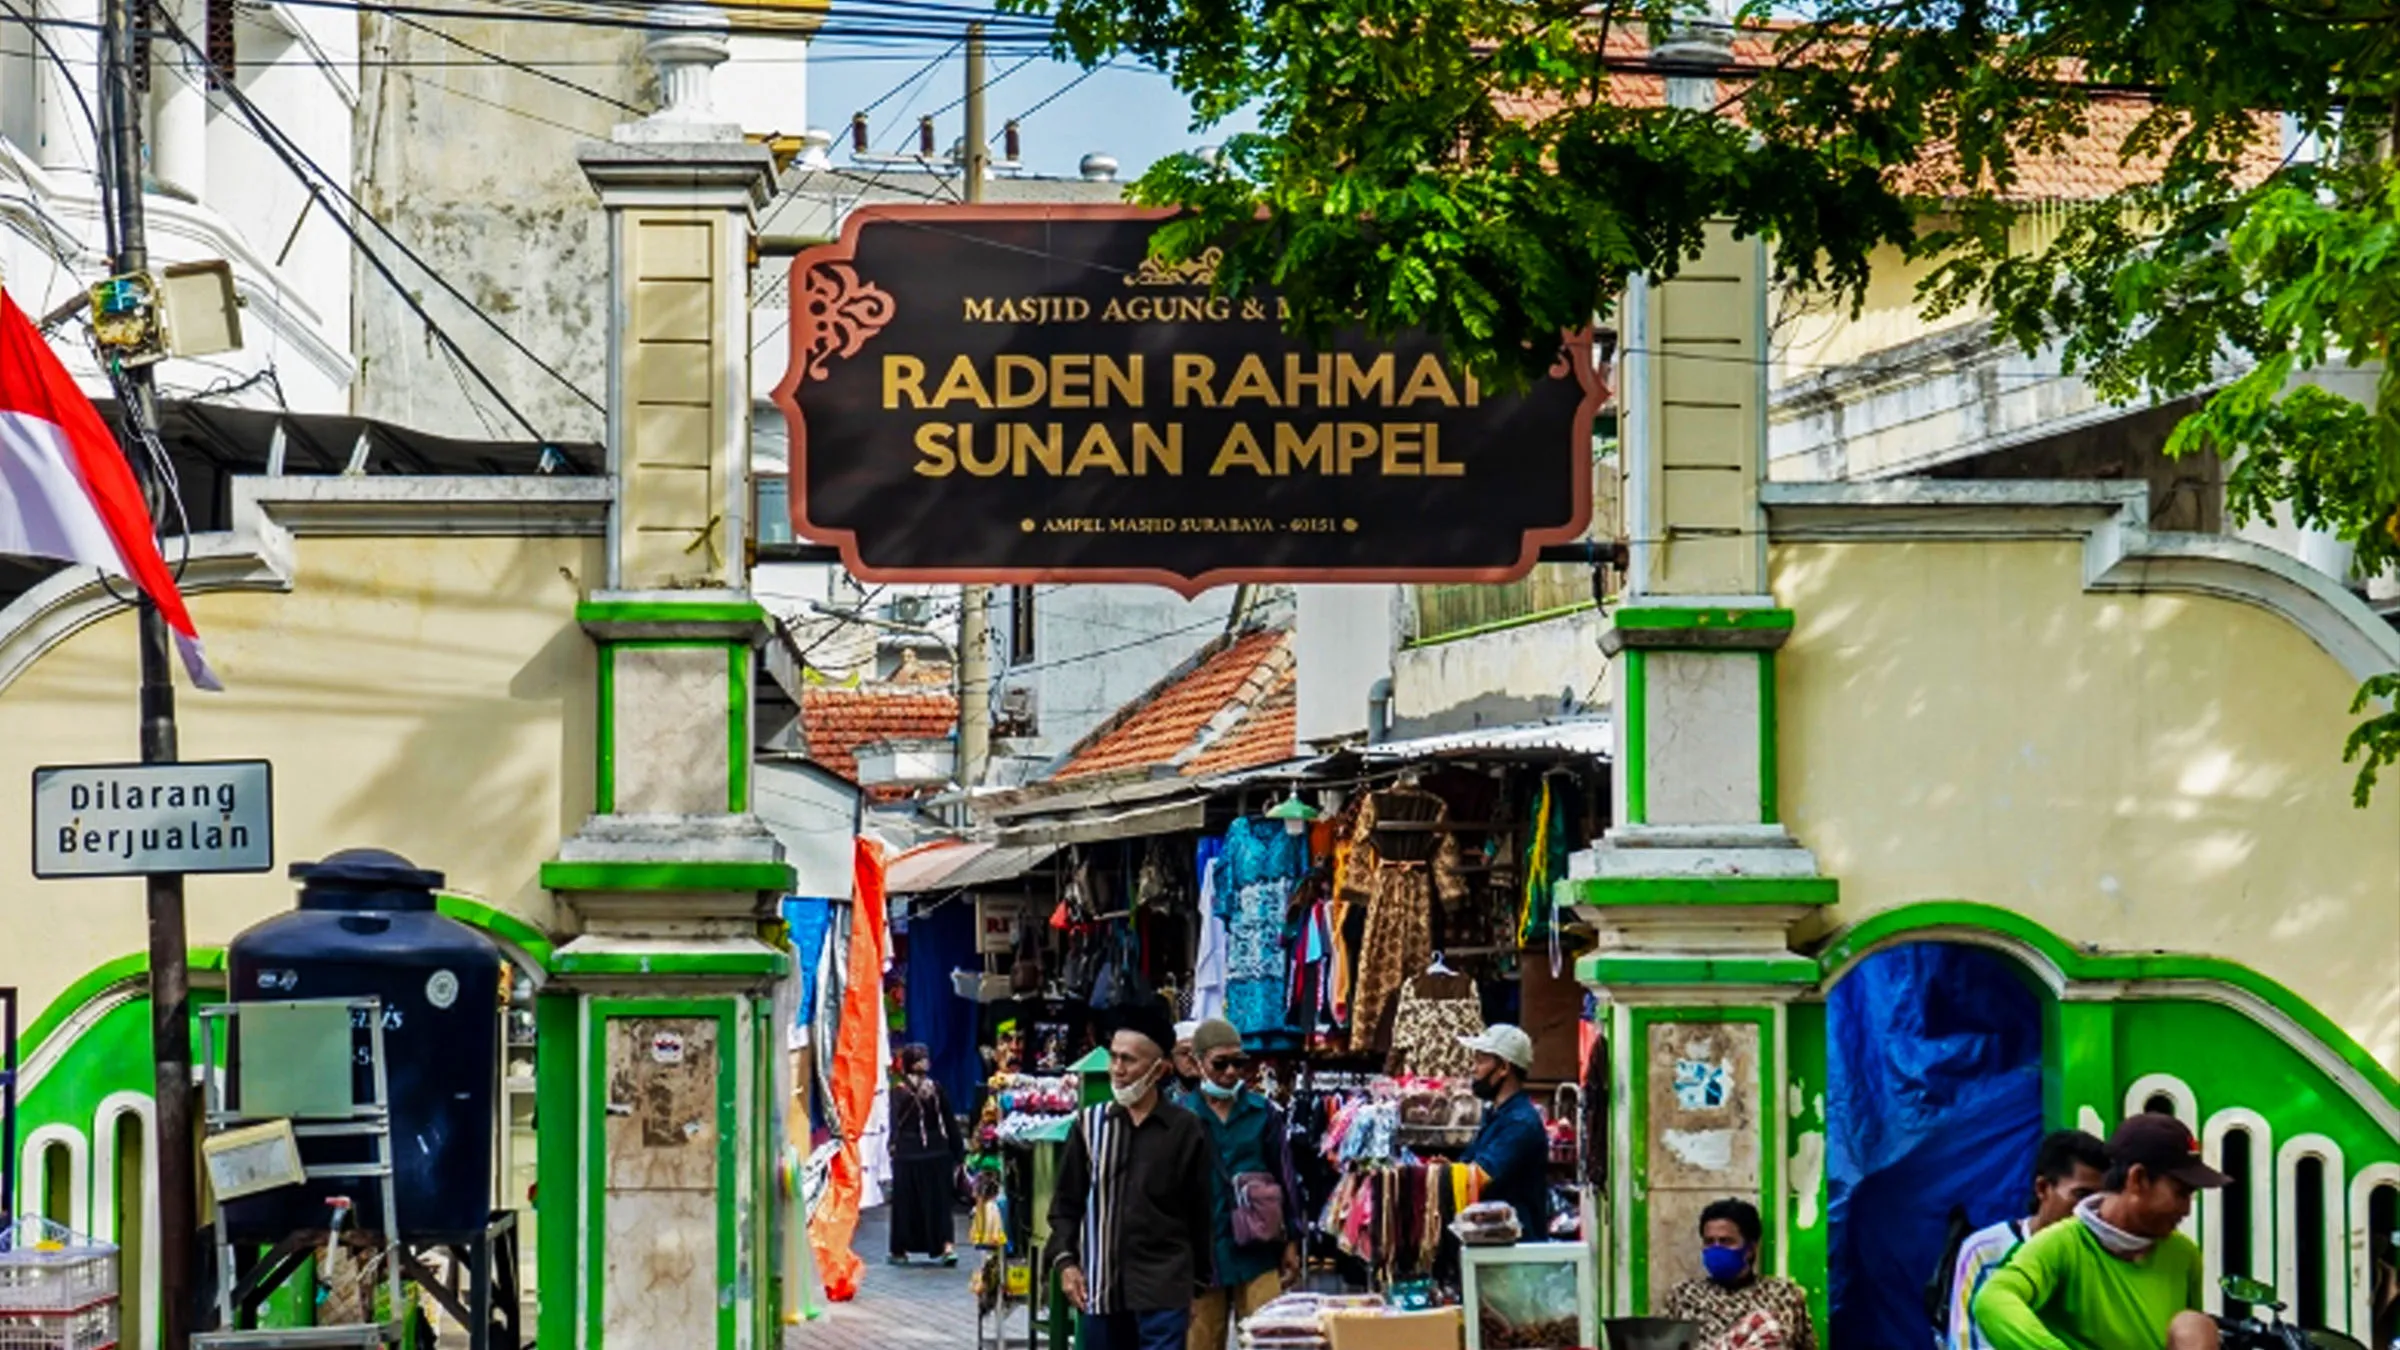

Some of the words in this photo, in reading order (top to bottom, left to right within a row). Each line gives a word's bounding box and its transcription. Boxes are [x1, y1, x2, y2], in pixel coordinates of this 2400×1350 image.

[963, 297, 1090, 325] MASJID
[1101, 297, 1230, 322] AGUNG
[1240, 297, 1266, 321] &
[883, 354, 1143, 409] RADEN
[913, 422, 1183, 477] SUNAN
[1208, 422, 1465, 477] AMPEL
[1043, 517, 1105, 533] AMPEL
[1108, 517, 1176, 535] MASJID
[1180, 517, 1275, 532] SURABAYA
[71, 781, 235, 813] Dilarang
[59, 821, 248, 858] Berjualan
